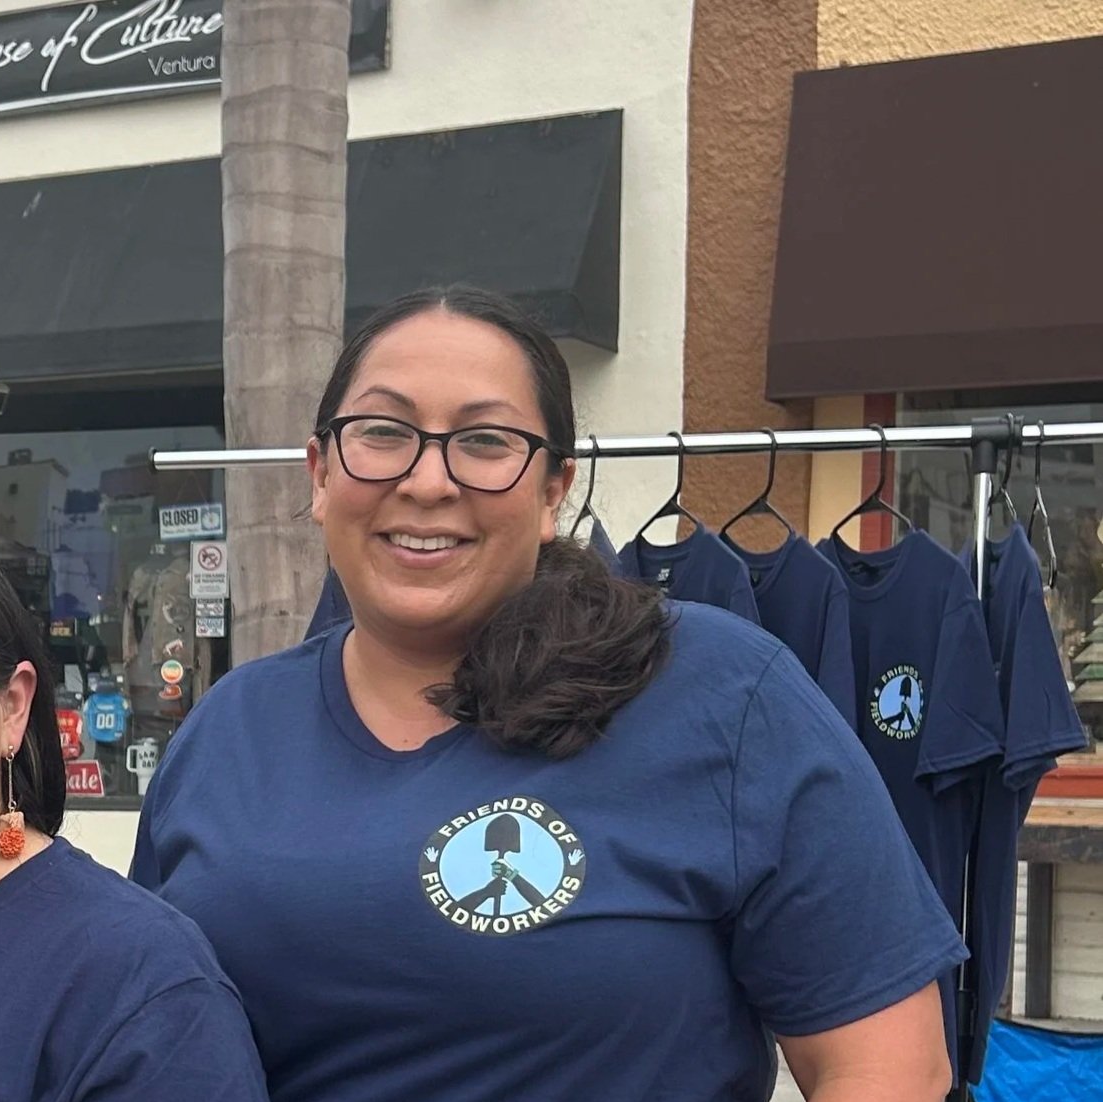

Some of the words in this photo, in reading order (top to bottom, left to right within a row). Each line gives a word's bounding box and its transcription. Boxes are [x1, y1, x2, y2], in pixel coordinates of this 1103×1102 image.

[40, 4, 97, 91] of
[81, 0, 224, 65] Culture
[148, 54, 216, 76] Ventura
[161, 508, 198, 527] CLOSED
[96, 713, 115, 729] 00
[66, 767, 98, 790] ale
[438, 797, 545, 838] FRIENDS
[548, 820, 577, 844] OF
[422, 872, 580, 933] FIELDWORKERS
